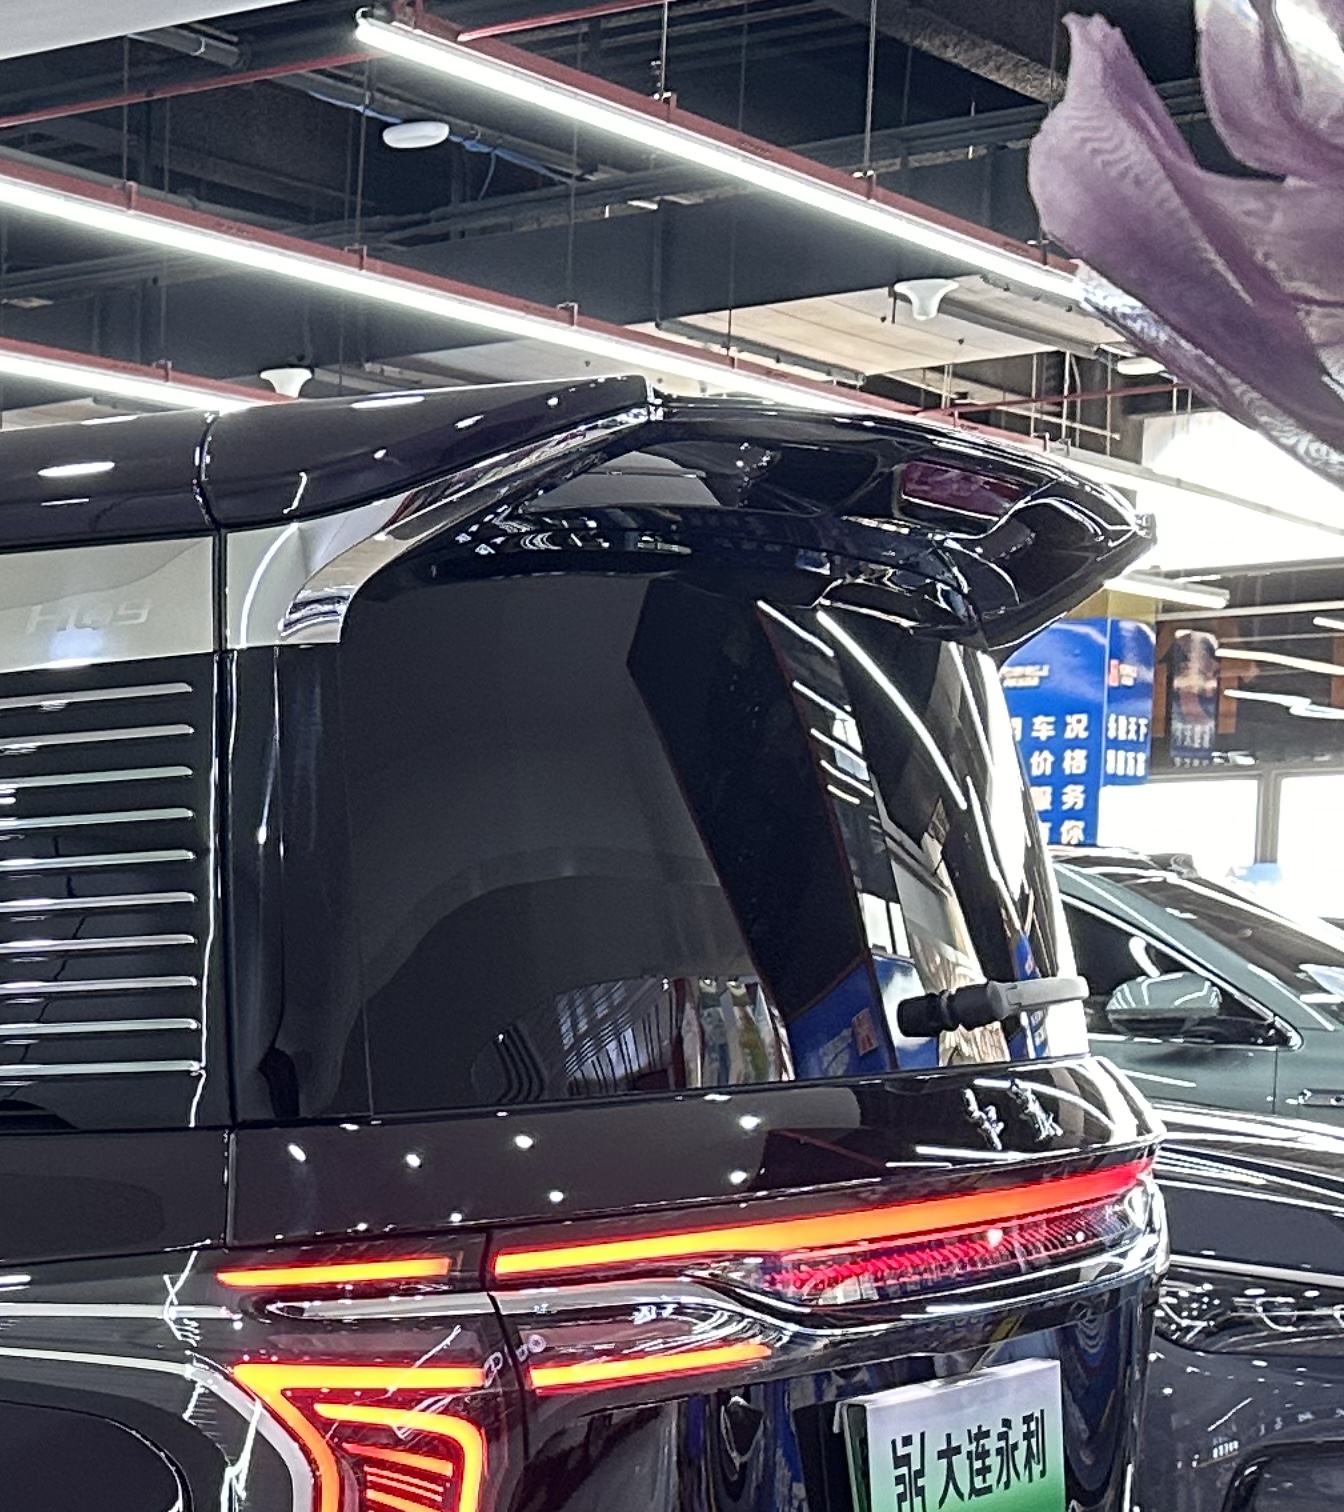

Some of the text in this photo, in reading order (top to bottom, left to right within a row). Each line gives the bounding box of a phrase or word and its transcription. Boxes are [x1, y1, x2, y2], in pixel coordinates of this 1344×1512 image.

[1029, 748, 1089, 777] 价格
[936, 1408, 1048, 1510] 大连永利
